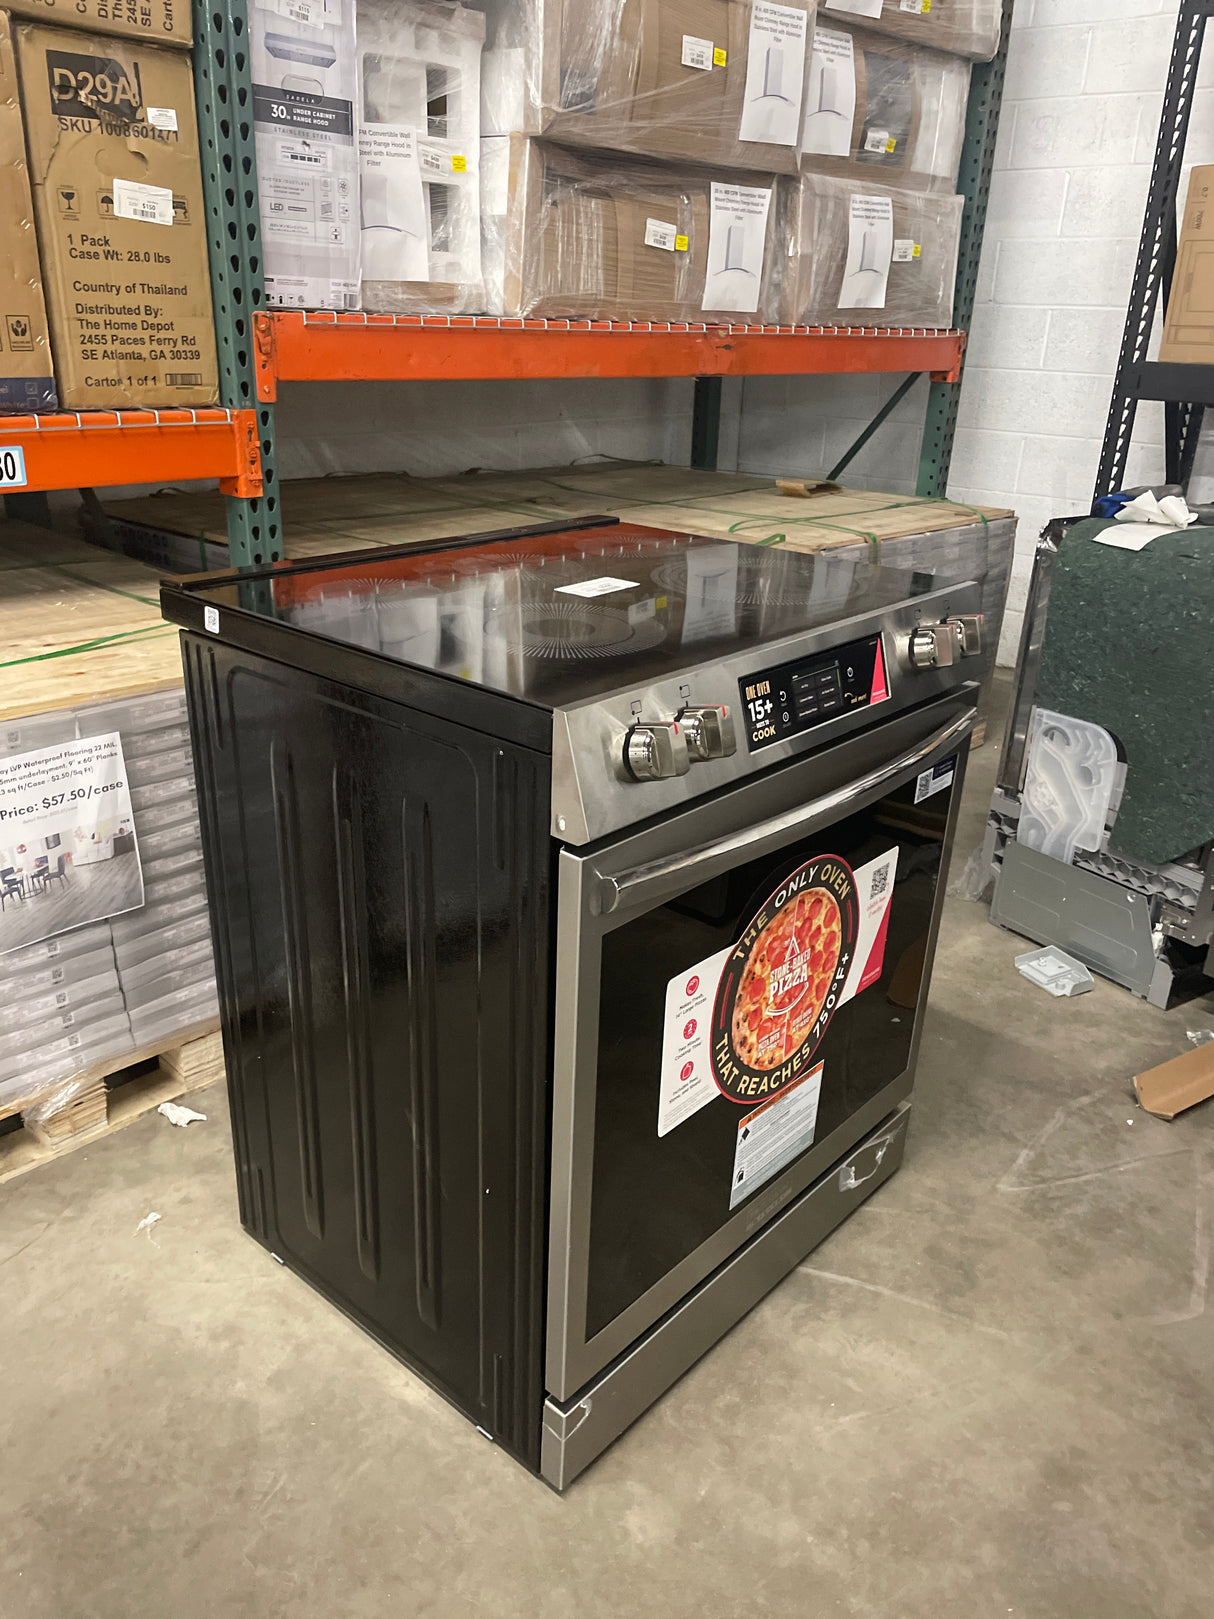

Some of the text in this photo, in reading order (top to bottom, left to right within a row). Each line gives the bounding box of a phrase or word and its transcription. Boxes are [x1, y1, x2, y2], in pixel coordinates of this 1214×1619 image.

[271, 104, 286, 119] 30
[293, 108, 336, 120] UNDER CABINET
[60, 118, 92, 134] SKU
[293, 116, 312, 124] RANGE
[273, 127, 332, 141] STAINLESS STEEL
[368, 130, 398, 138] Convertible
[270, 202, 284, 211] LED
[67, 234, 111, 247] 1 Pack
[69, 248, 171, 264] Case Wt: 28.0 lbs
[73, 281, 188, 296] Country of Thailand
[75, 303, 163, 317] Distributed By:
[78, 319, 175, 333] The Home Depot
[80, 335, 196, 348] 2455 Paces Ferry Rd
[81, 350, 201, 362] SE Atlanta, GA 30339
[85, 375, 158, 387] Carton 1 of 1
[748, 698, 774, 722] 15+
[752, 725, 776, 742] COOK
[9, 763, 22, 773] LVP
[23, 753, 63, 768] Waterproof
[64, 747, 93, 758] Flooring
[18, 764, 68, 781] underlayment,
[96, 752, 118, 761] Planks
[18, 780, 45, 791] ft/Case
[0, 803, 39, 820] Price:
[42, 780, 124, 810] $57.50/case
[733, 911, 767, 961] THE
[774, 864, 819, 908] ONLY
[820, 863, 850, 900] OVEN
[768, 962, 808, 1004] PIZZA
[715, 1033, 739, 1086] THAT
[737, 1044, 811, 1096] REACHES
